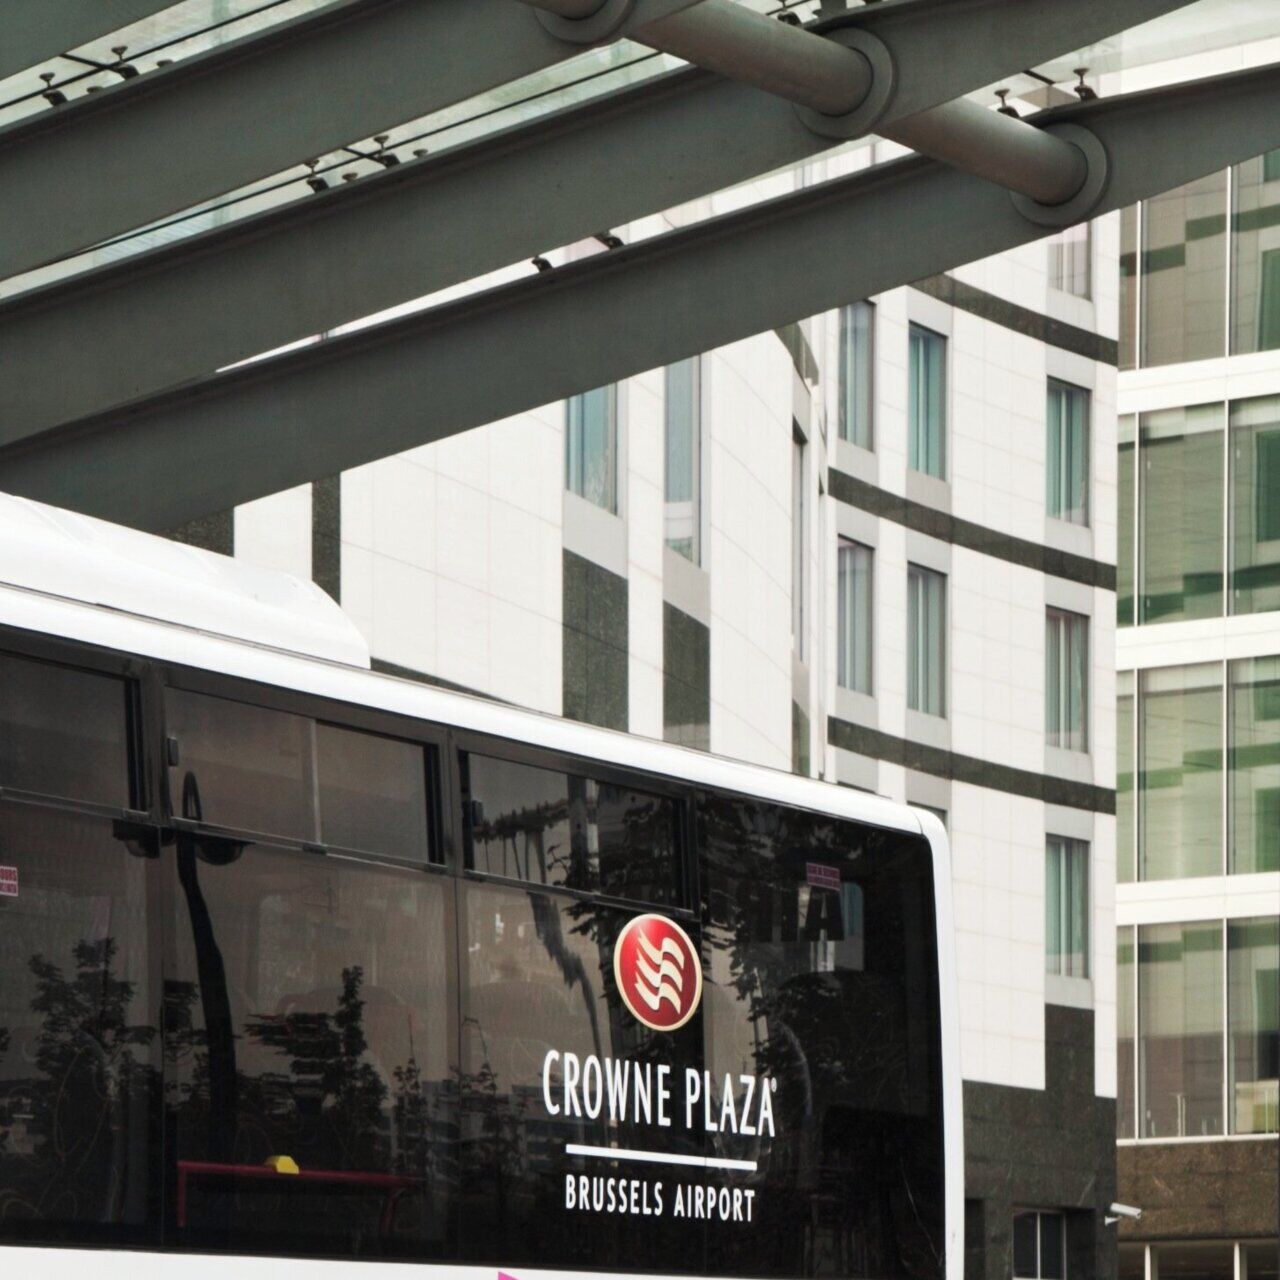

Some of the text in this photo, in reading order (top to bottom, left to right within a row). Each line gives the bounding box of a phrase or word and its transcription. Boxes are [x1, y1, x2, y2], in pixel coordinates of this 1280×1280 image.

[542, 1050, 671, 1126] CROWNE
[566, 1174, 755, 1222] BRUSSELS AIRPORT
